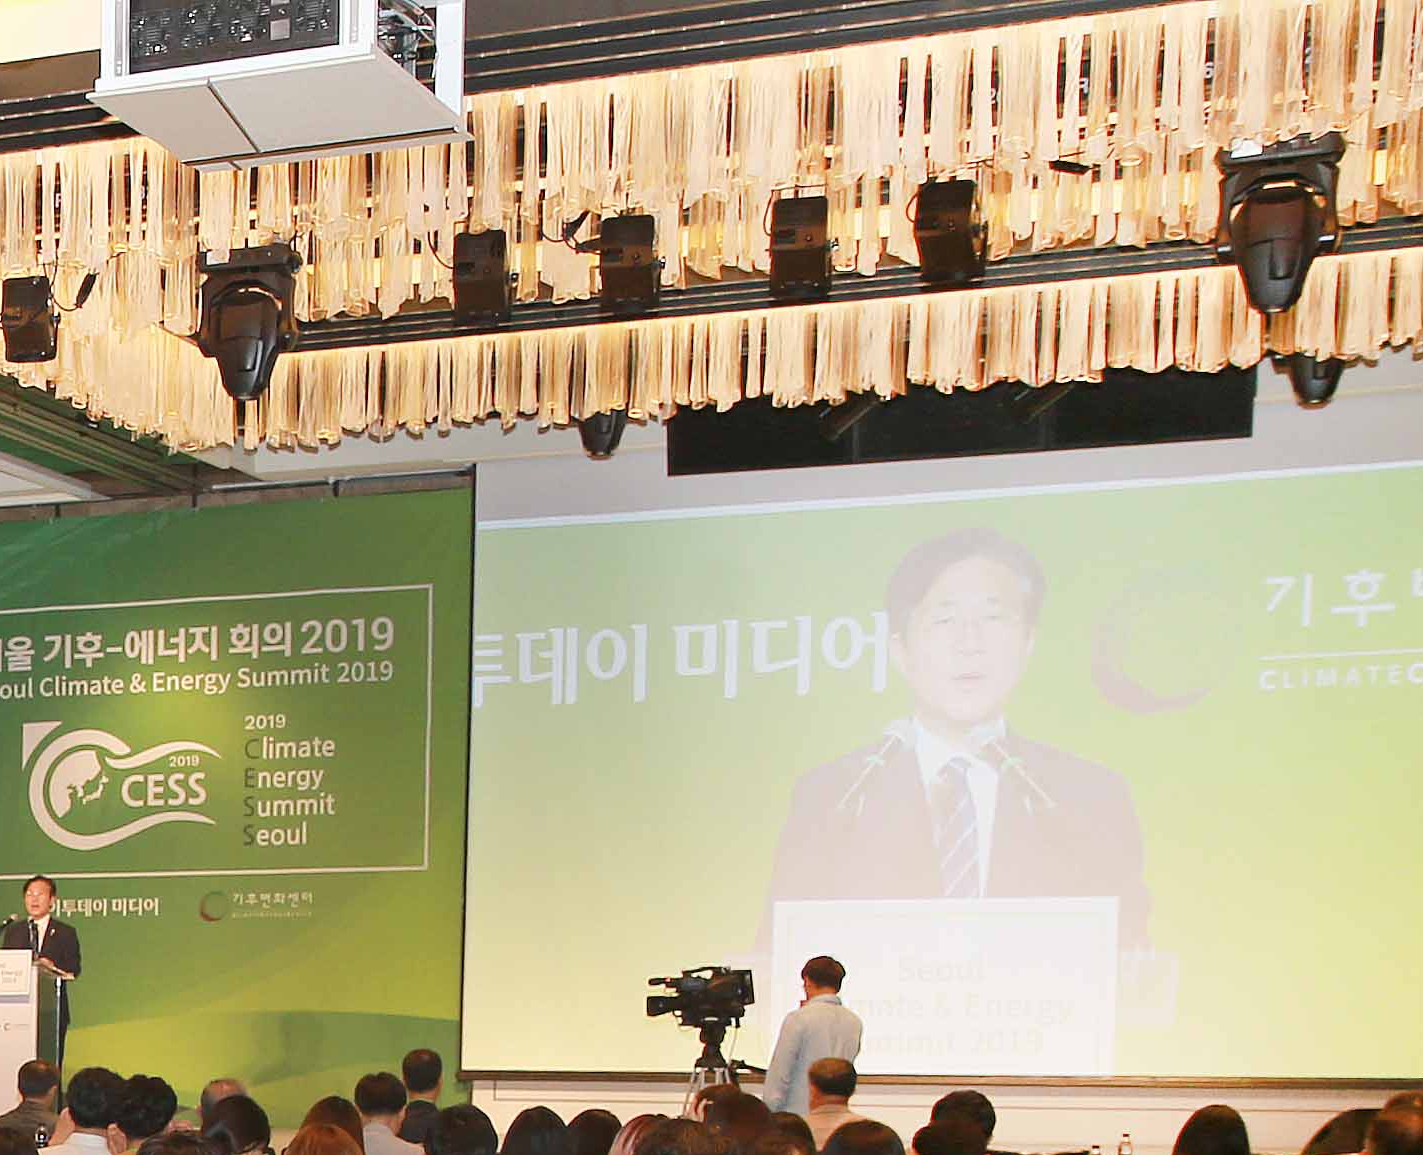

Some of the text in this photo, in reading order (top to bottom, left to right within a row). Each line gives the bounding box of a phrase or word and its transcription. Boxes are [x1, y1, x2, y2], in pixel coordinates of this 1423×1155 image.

[43, 624, 220, 670] 기후-에너지
[228, 621, 292, 659] 회의
[299, 616, 395, 656] 2019
[673, 610, 889, 699] 미디어
[38, 674, 125, 699] Climate
[129, 674, 147, 695] &
[152, 669, 232, 696] Energy
[236, 662, 330, 688] Summit
[337, 660, 395, 684] 2019
[244, 713, 287, 731] 2019
[244, 735, 336, 760] Climate
[169, 755, 200, 768] 2019
[121, 771, 208, 808] CESS
[244, 766, 324, 791] Energy
[243, 792, 336, 818] Summit
[243, 821, 308, 847] Seoul
[111, 896, 160, 917] 미디어
